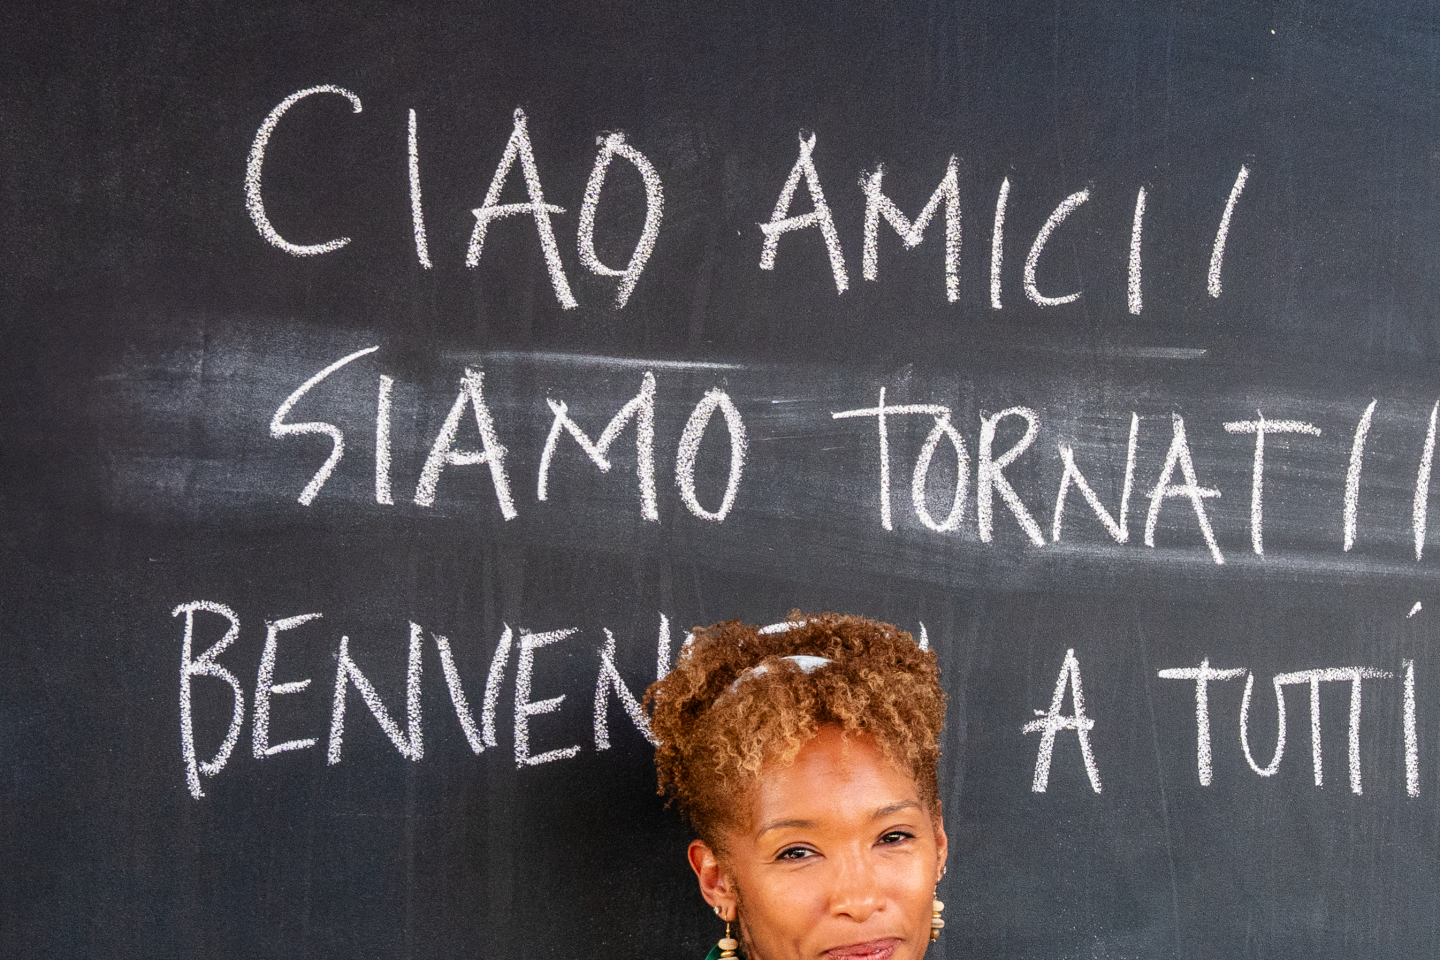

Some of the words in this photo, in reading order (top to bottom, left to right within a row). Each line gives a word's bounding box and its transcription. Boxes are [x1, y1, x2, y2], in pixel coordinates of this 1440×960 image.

[246, 84, 663, 309] CIAO
[269, 344, 748, 520] SIAMO
[173, 601, 928, 798] BENVEN
[1023, 648, 1102, 794] A
